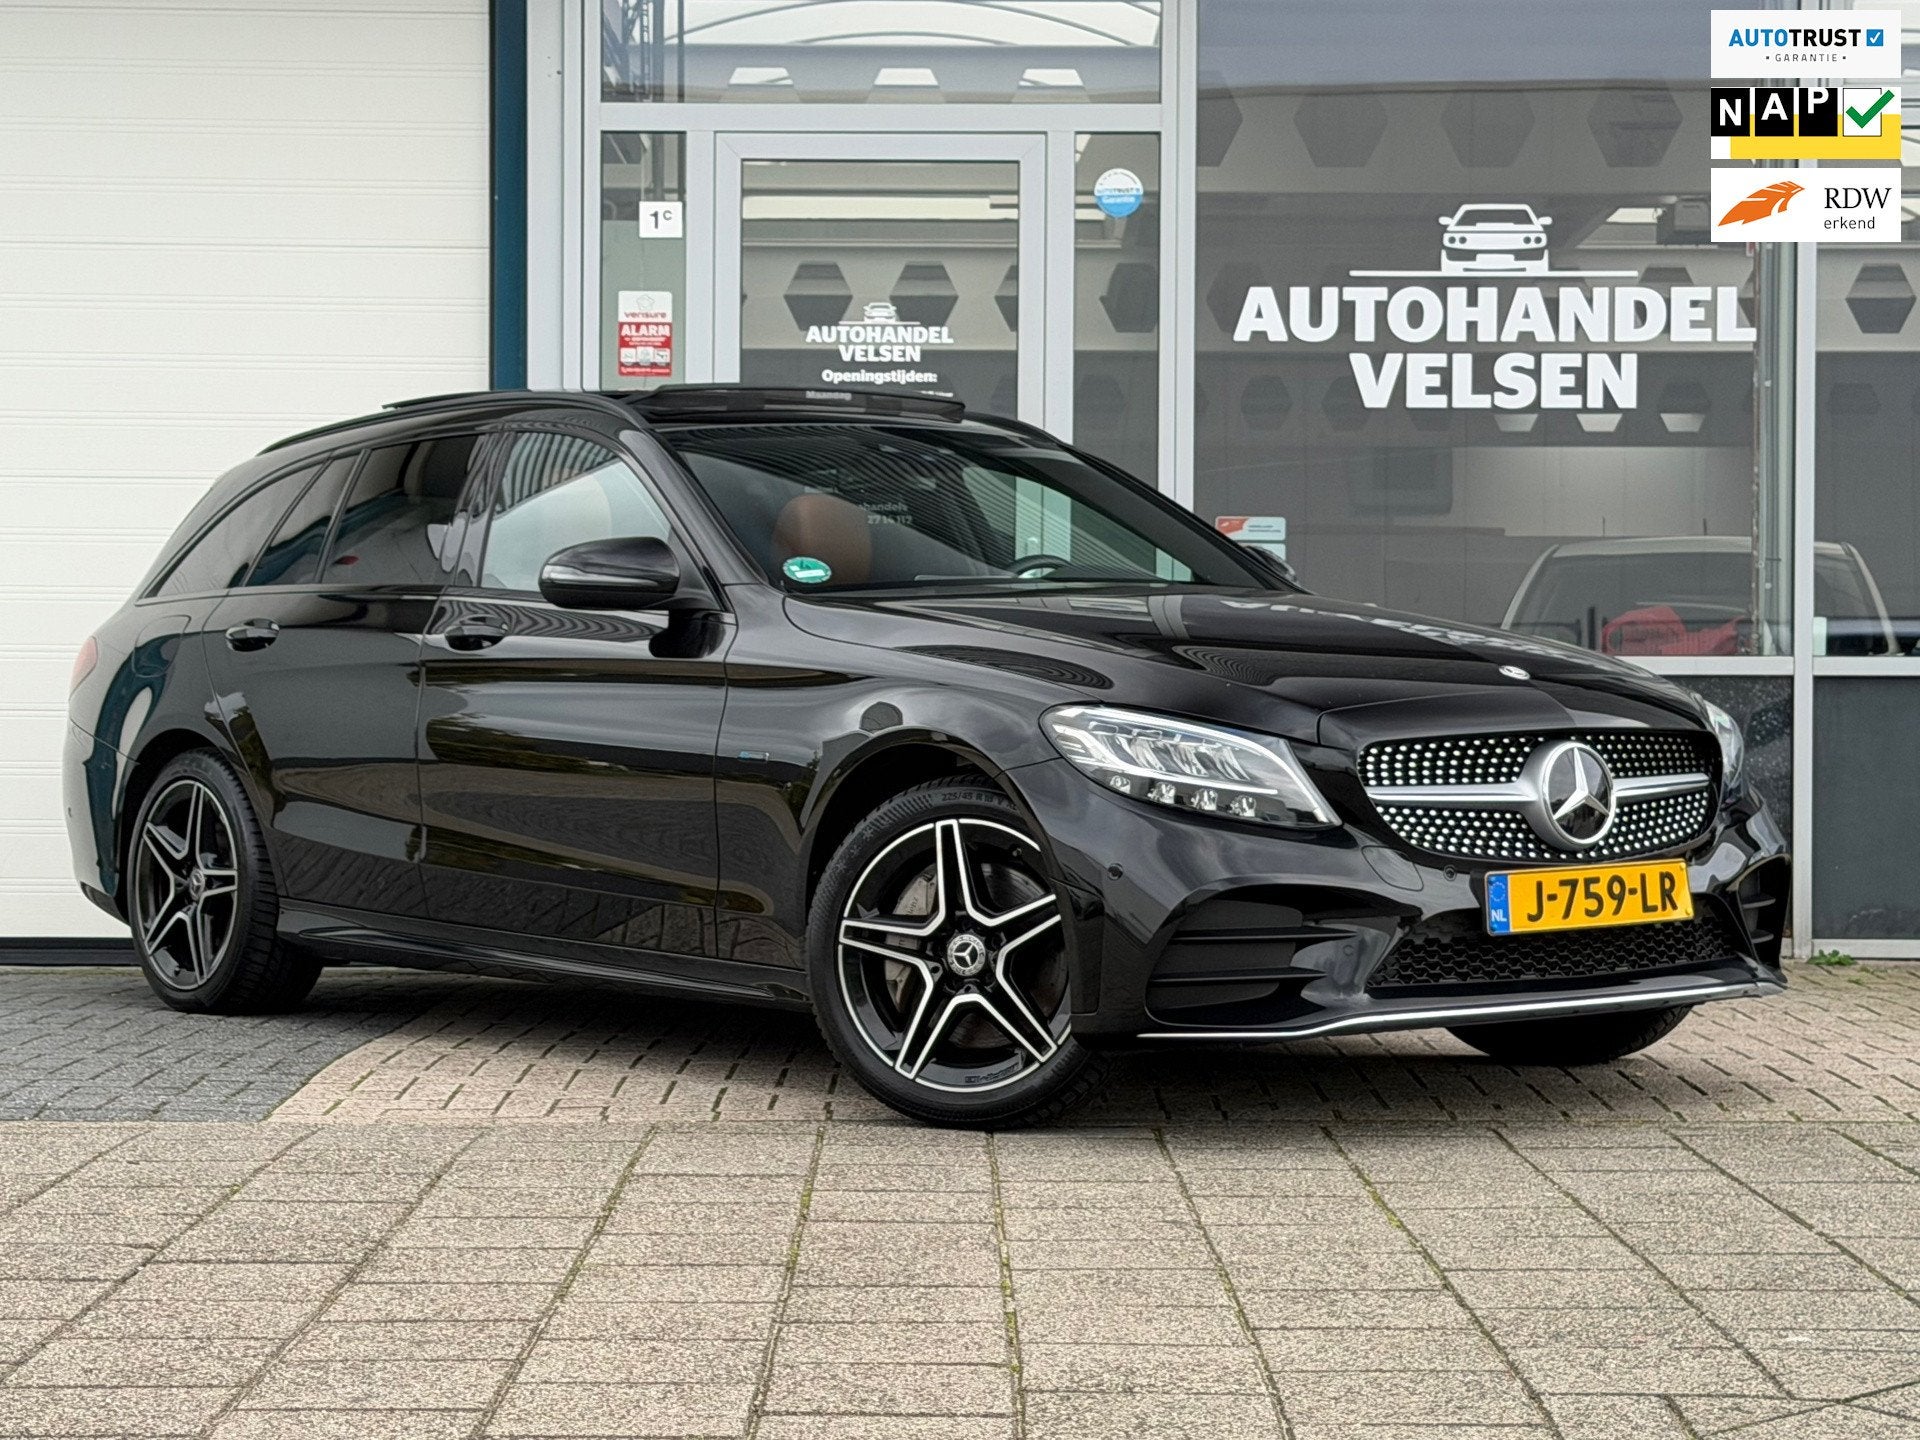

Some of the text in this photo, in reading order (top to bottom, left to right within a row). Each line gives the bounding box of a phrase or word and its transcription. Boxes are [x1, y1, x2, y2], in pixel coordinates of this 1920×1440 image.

[1233, 286, 1757, 342] AUTOHANDEL
[621, 324, 671, 337] ALARM
[805, 325, 955, 343] AUTOHANDEL
[838, 345, 922, 362] VELSEN
[821, 368, 939, 384] Openingstijden:
[1349, 352, 1638, 409] VELSEN
[1527, 871, 1679, 923] J-759-LR
[1491, 909, 1508, 922] NL
